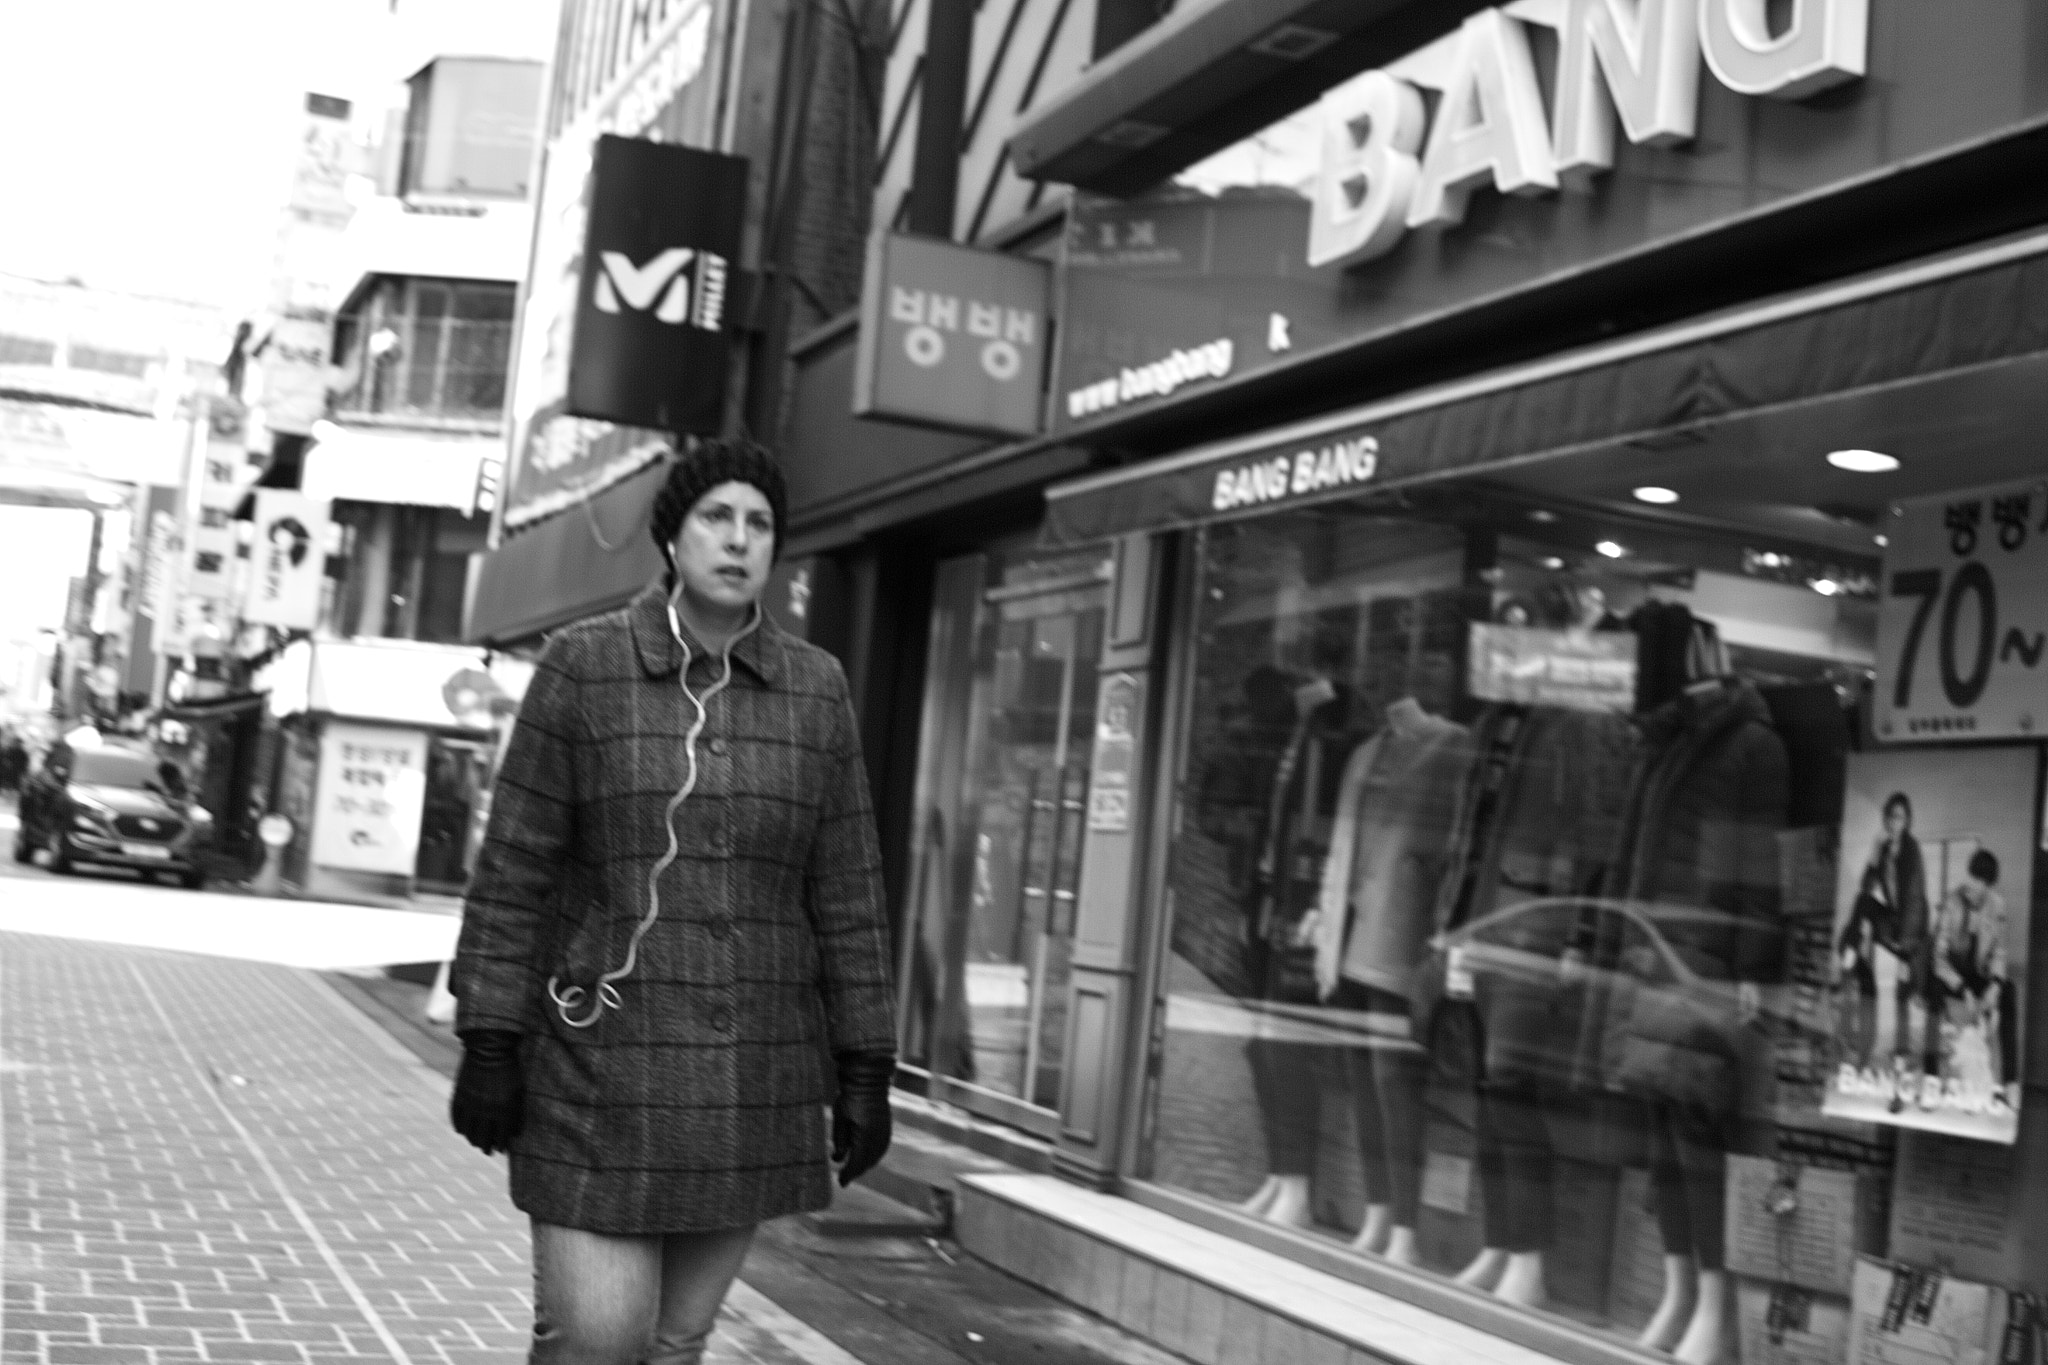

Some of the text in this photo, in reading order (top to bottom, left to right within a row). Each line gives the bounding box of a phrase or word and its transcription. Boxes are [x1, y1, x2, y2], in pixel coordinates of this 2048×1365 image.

[890, 285, 1034, 382] 뱅뱅
[1212, 435, 1379, 510] BANG BANG
